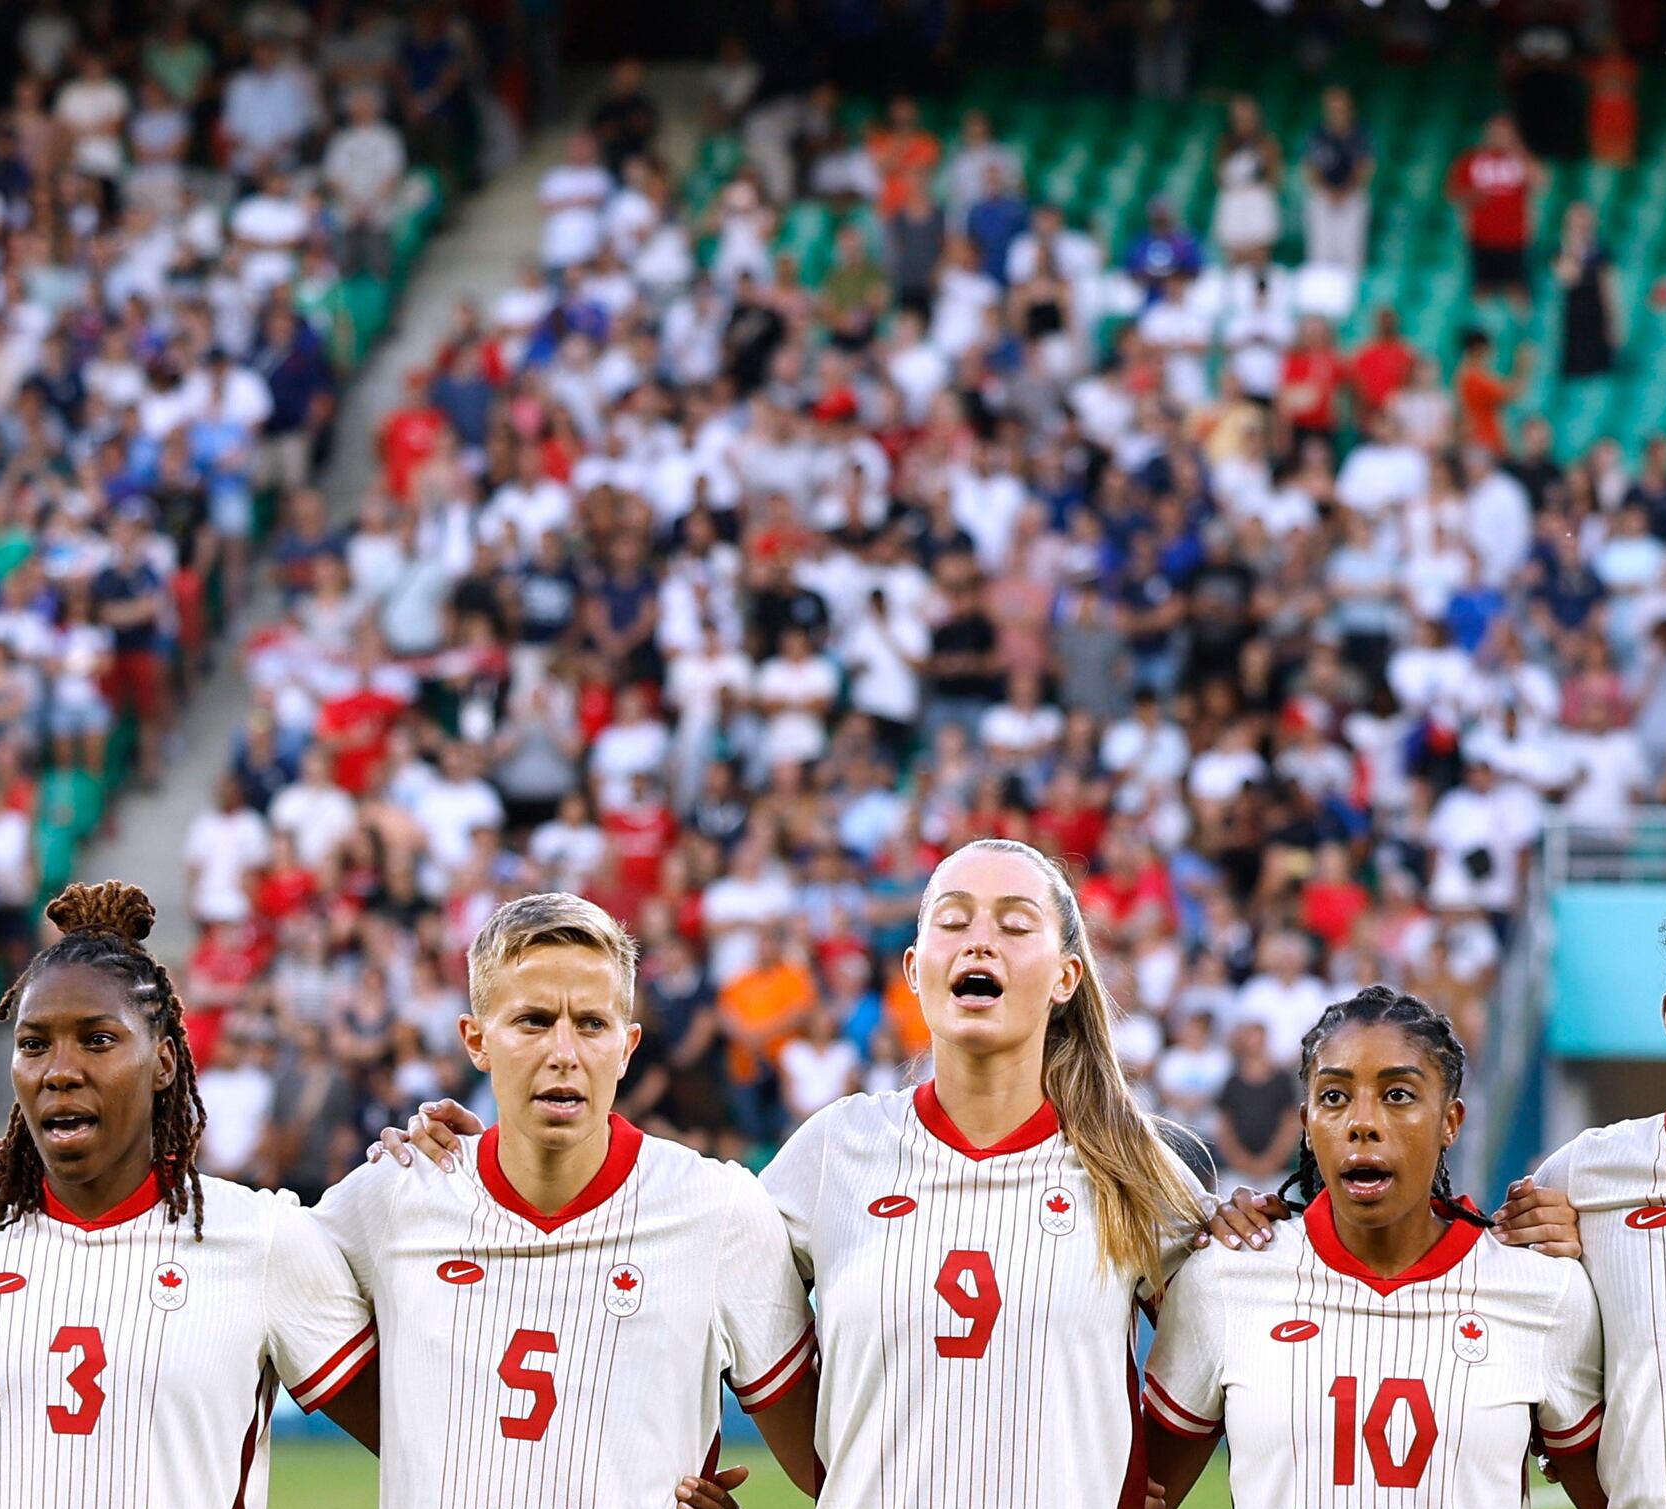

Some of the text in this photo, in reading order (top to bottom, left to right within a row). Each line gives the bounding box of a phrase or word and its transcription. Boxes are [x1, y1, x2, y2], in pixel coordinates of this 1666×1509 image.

[935, 1249, 1002, 1360] 9
[46, 1326, 107, 1436] 3
[497, 1328, 559, 1442] 5
[1328, 1376, 1438, 1489] 10
